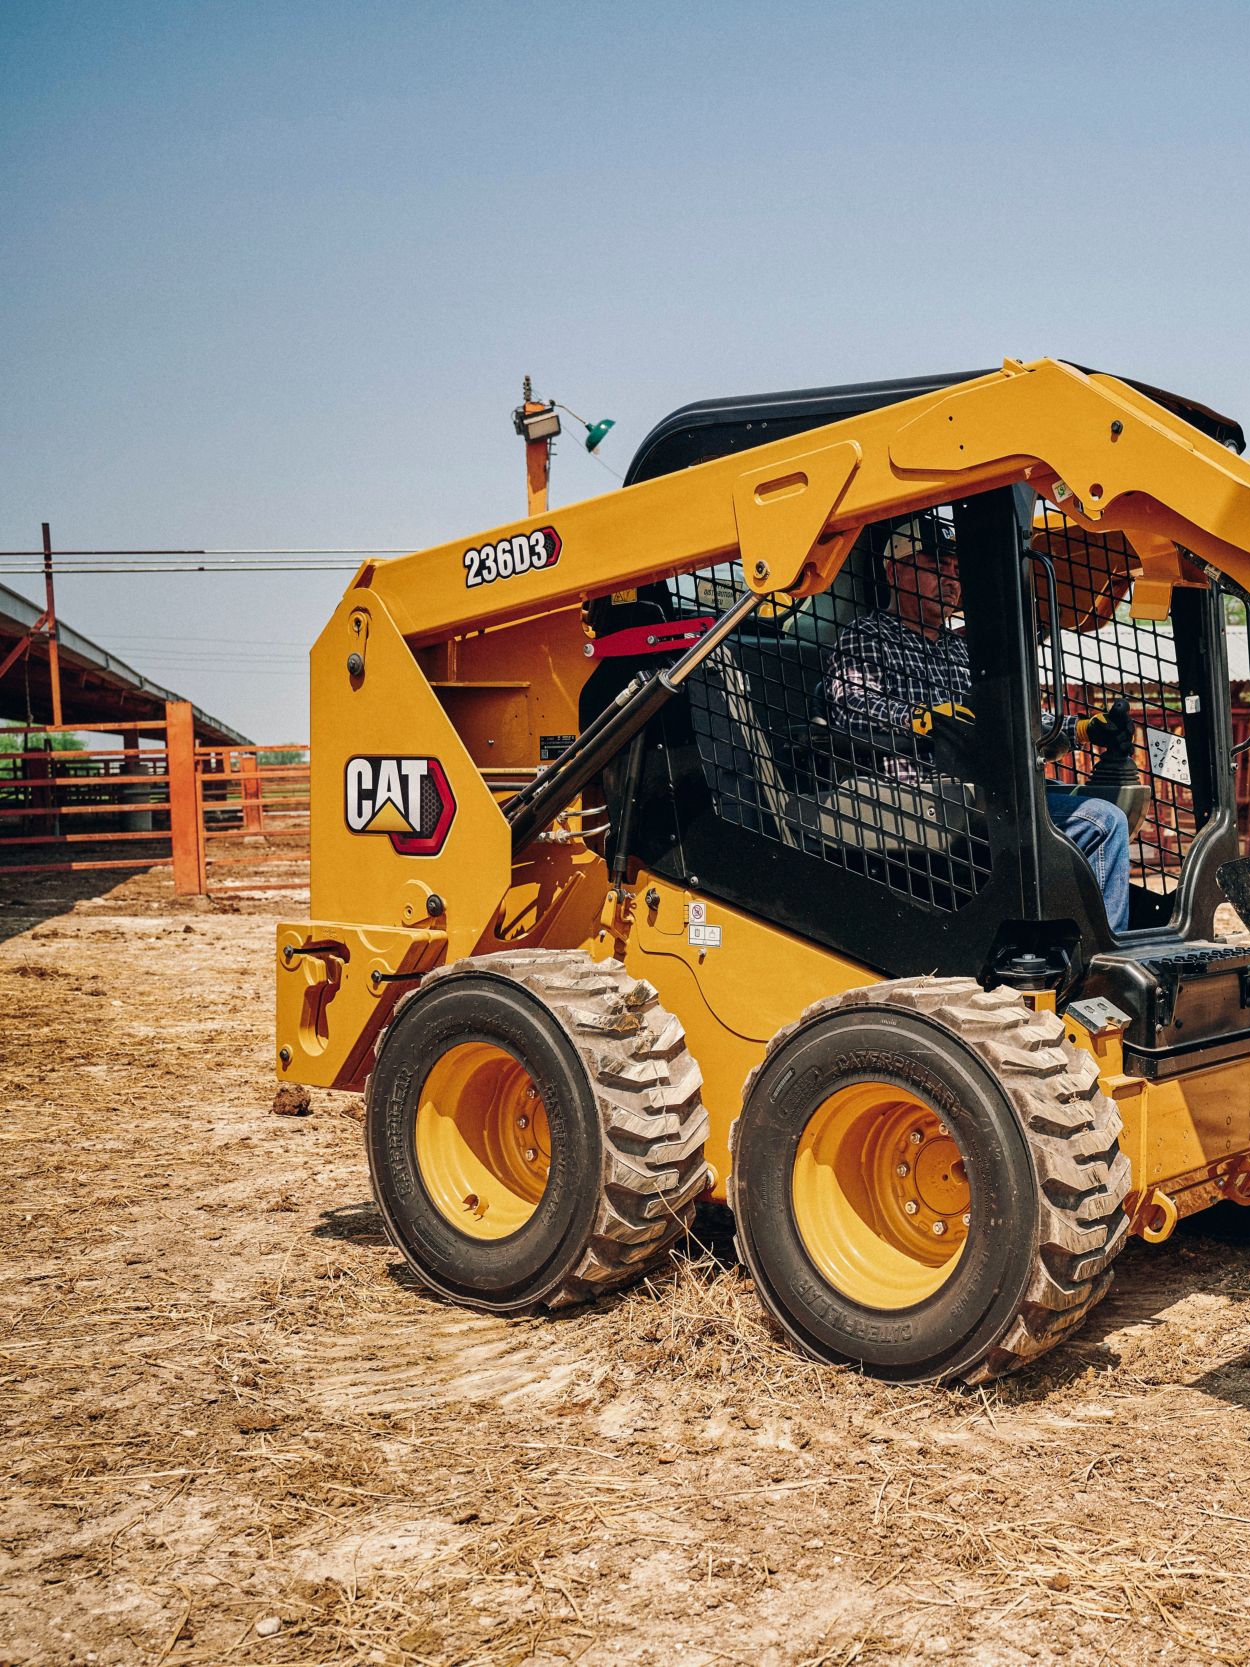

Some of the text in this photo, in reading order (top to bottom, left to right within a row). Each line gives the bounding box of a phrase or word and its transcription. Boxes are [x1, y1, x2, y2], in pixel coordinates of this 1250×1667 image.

[464, 531, 547, 586] 236D3
[347, 758, 428, 832] CAT
[836, 1049, 960, 1117] CATERPILLAR
[388, 1066, 414, 1197] CATERPILLAR
[791, 1278, 913, 1343] CATERPILLAR
